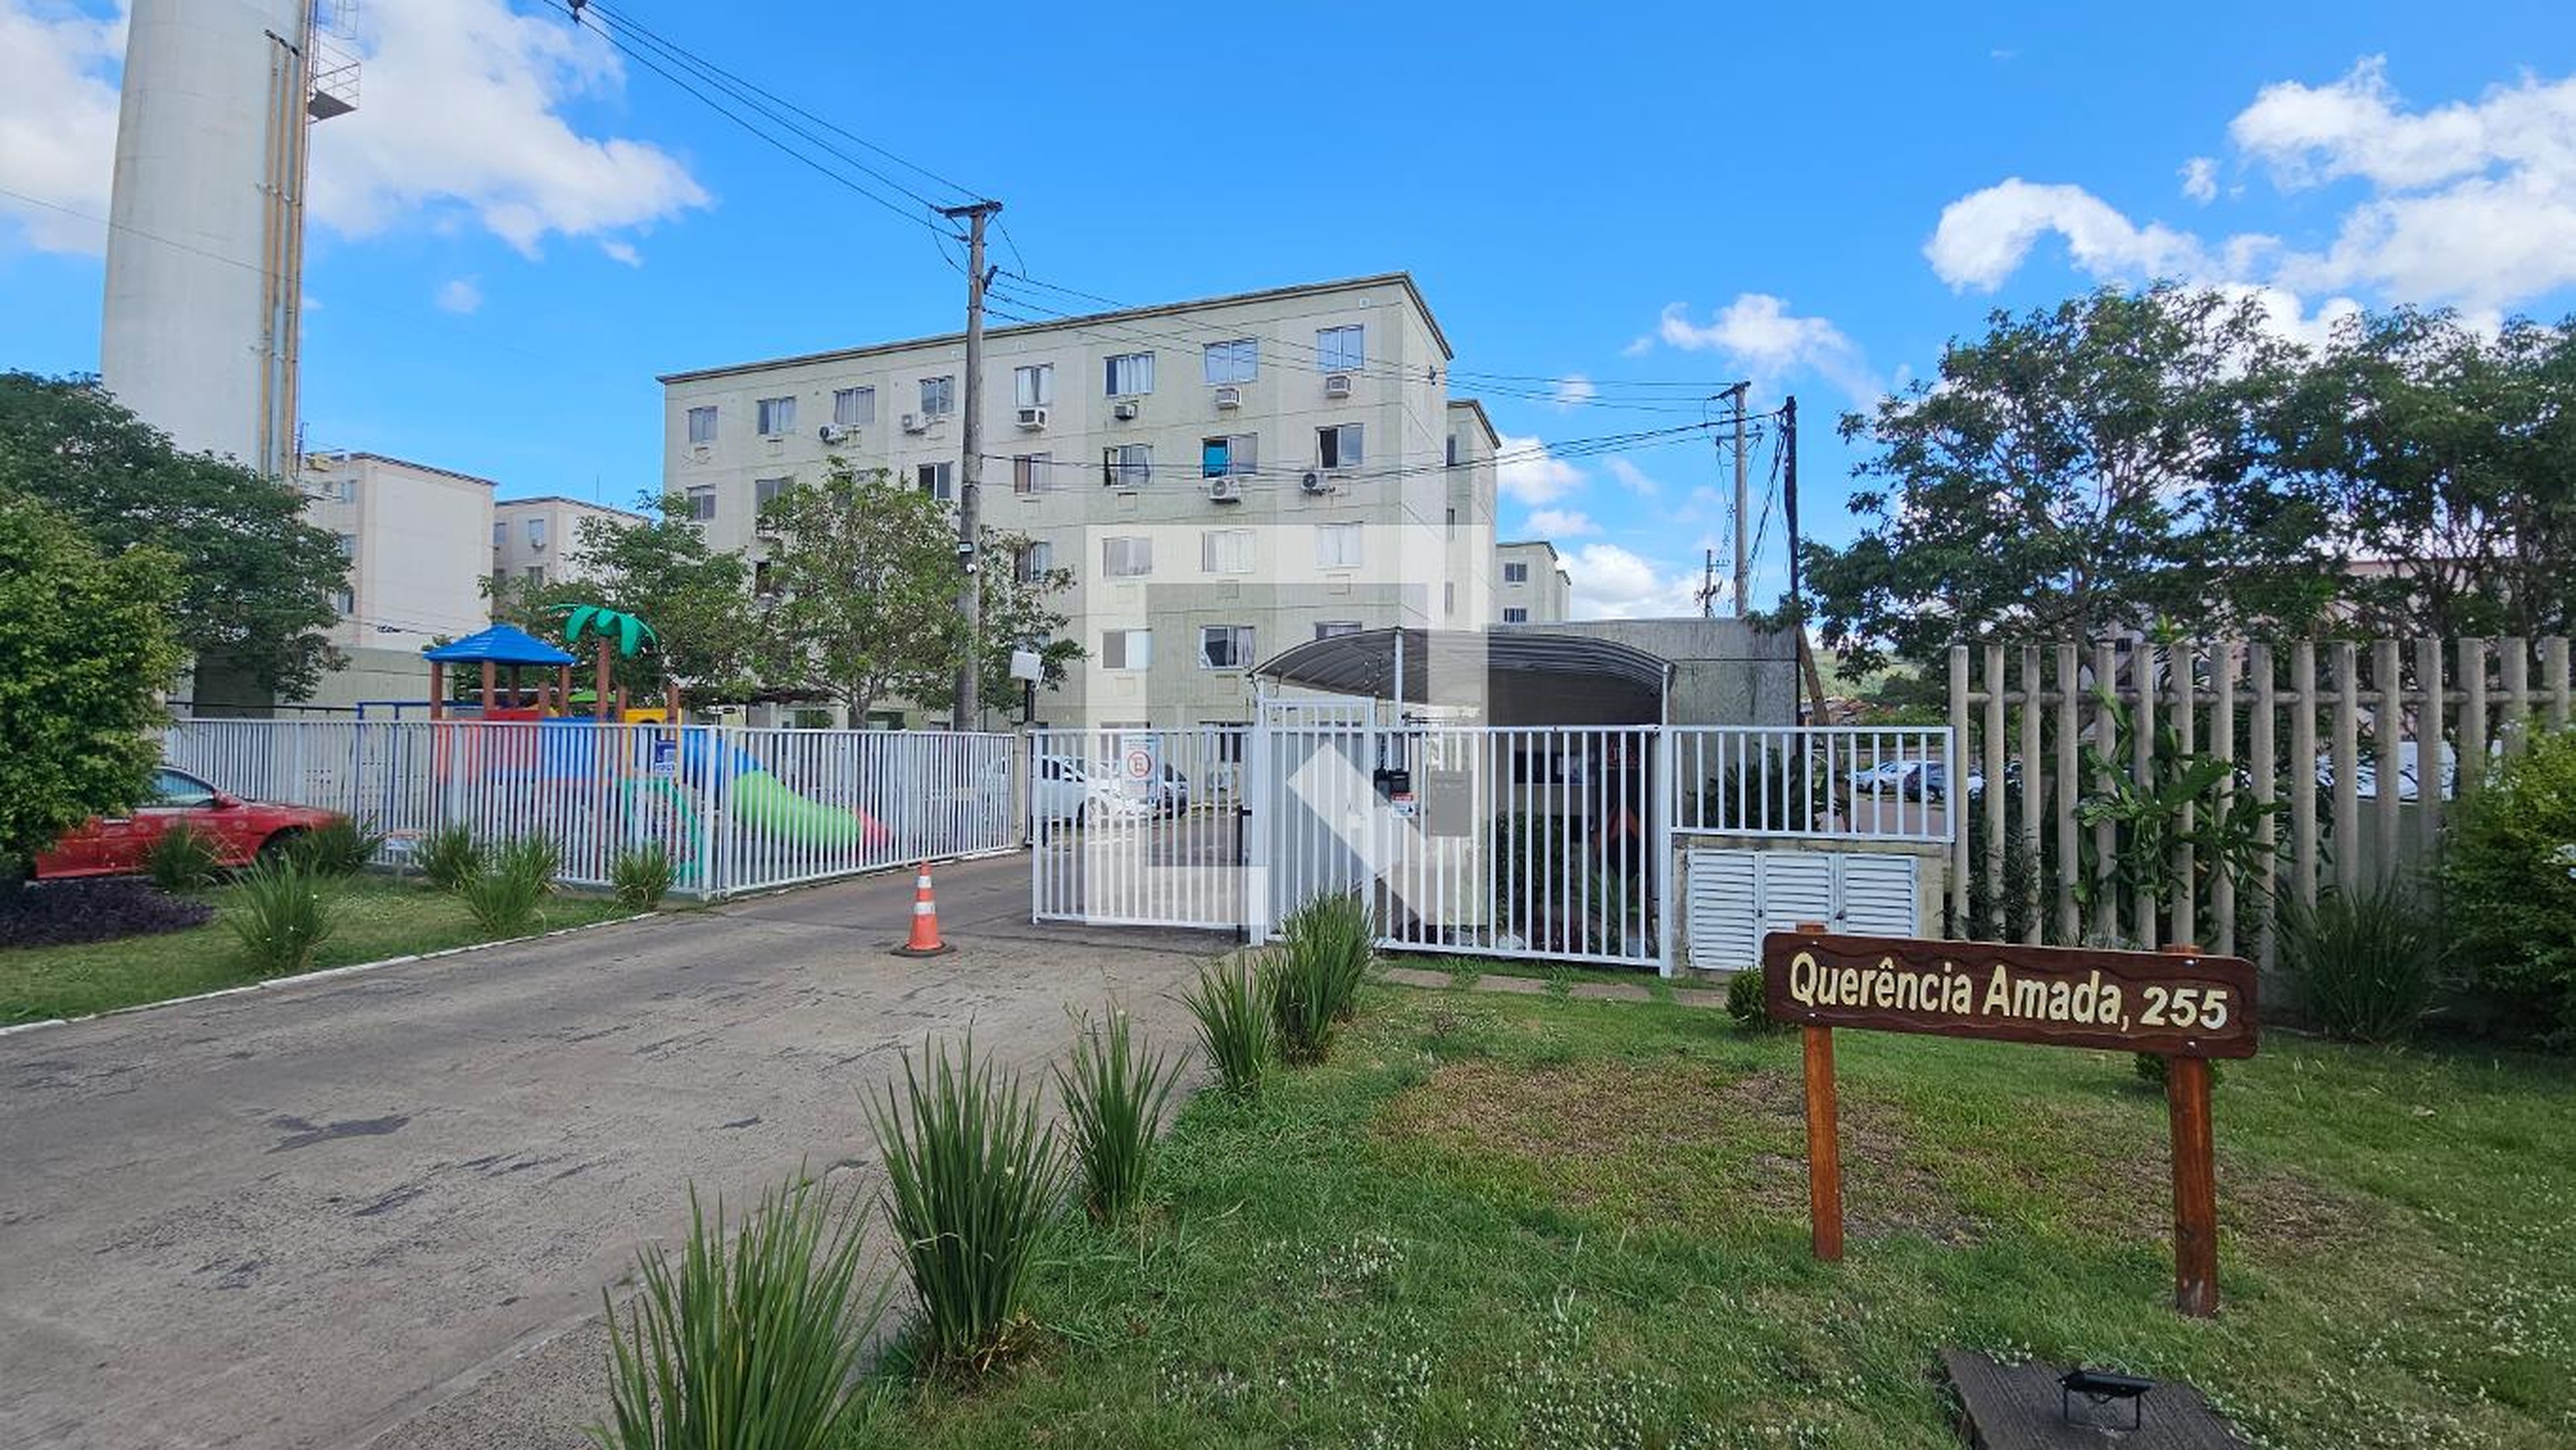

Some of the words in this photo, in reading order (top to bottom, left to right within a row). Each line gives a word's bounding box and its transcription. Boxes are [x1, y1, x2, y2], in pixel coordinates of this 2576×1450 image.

[1790, 952, 1972, 1015] Querência
[1982, 964, 2129, 1032] Amada,
[2140, 986, 2227, 1029] 255
